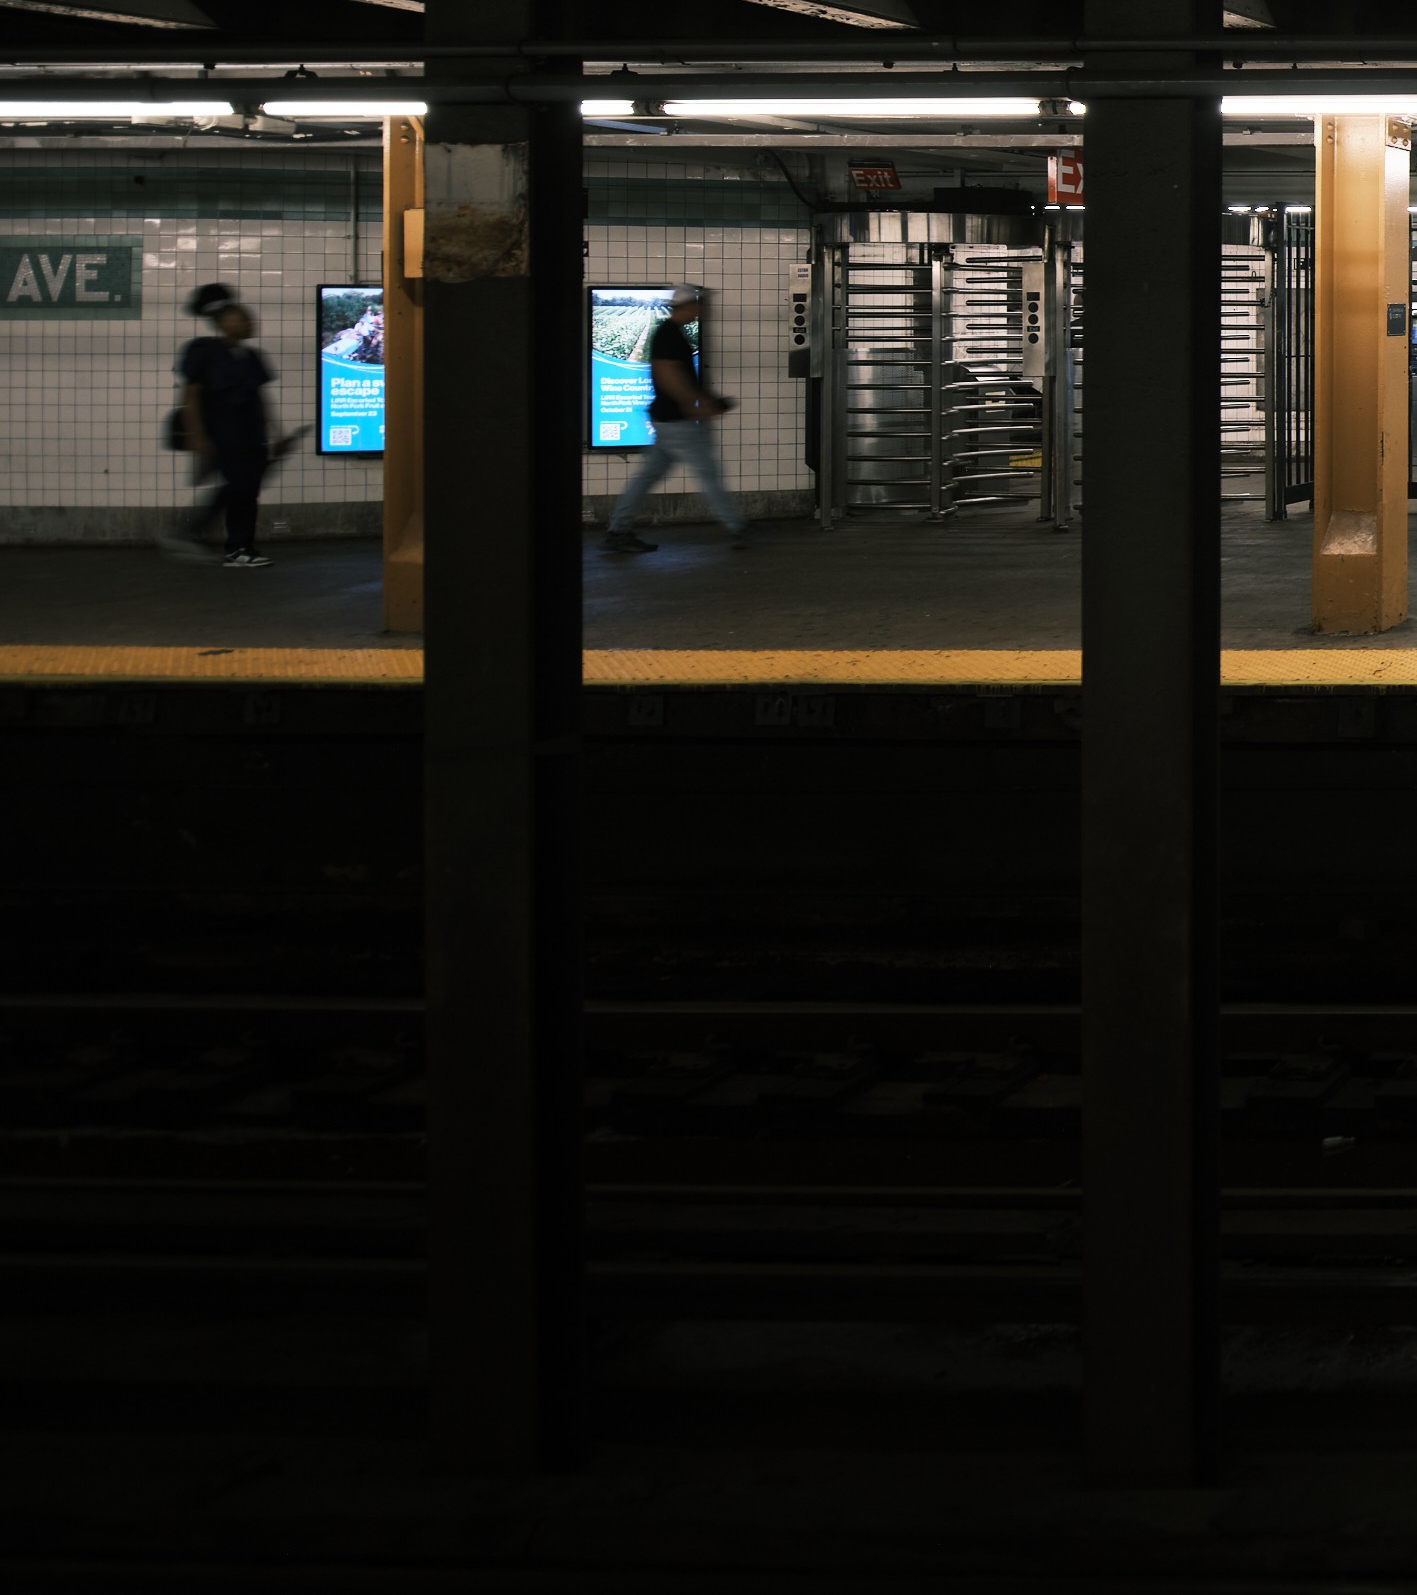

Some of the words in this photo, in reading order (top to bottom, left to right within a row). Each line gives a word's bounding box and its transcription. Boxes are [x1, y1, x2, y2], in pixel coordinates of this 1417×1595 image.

[851, 170, 895, 188] Exit
[6, 253, 122, 302] AVE.
[331, 377, 360, 387] Plan
[601, 377, 638, 385] Discover
[331, 387, 379, 397] escape
